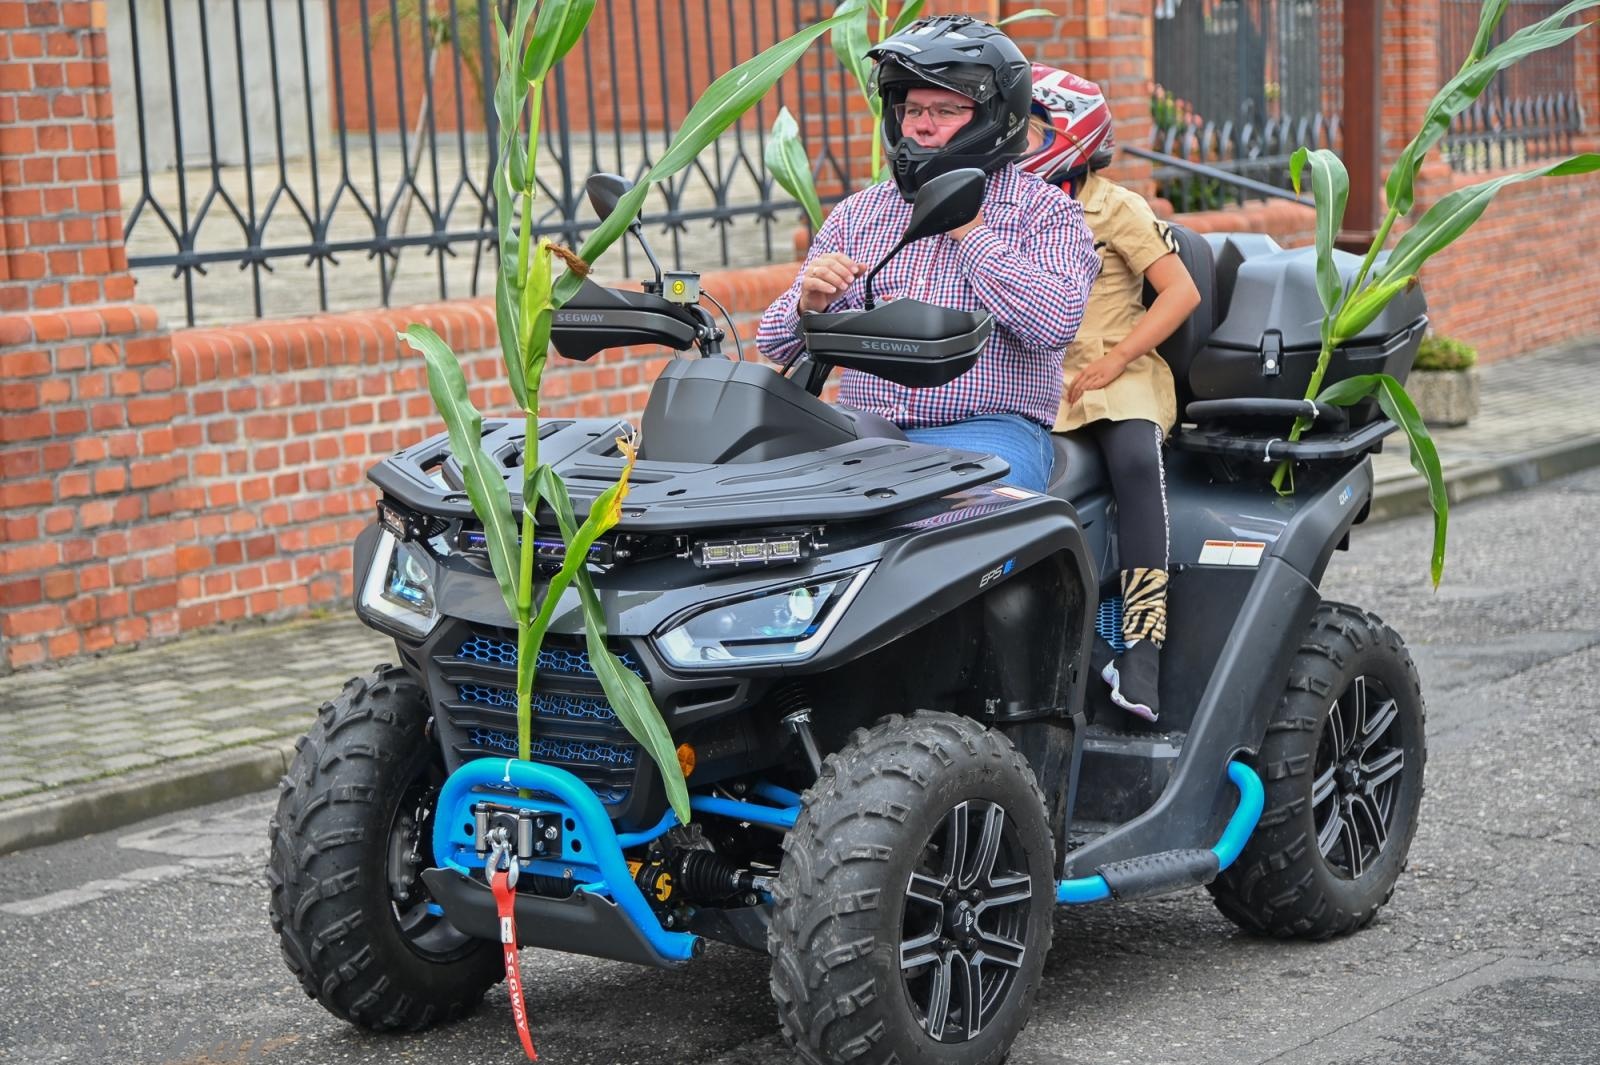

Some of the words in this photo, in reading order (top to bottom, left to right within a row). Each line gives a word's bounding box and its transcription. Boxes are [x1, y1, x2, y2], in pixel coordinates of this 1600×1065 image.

[557, 313, 604, 322] SEGWAY
[861, 340, 920, 353] SEGWAY
[506, 951, 526, 1032] SEGWAY
